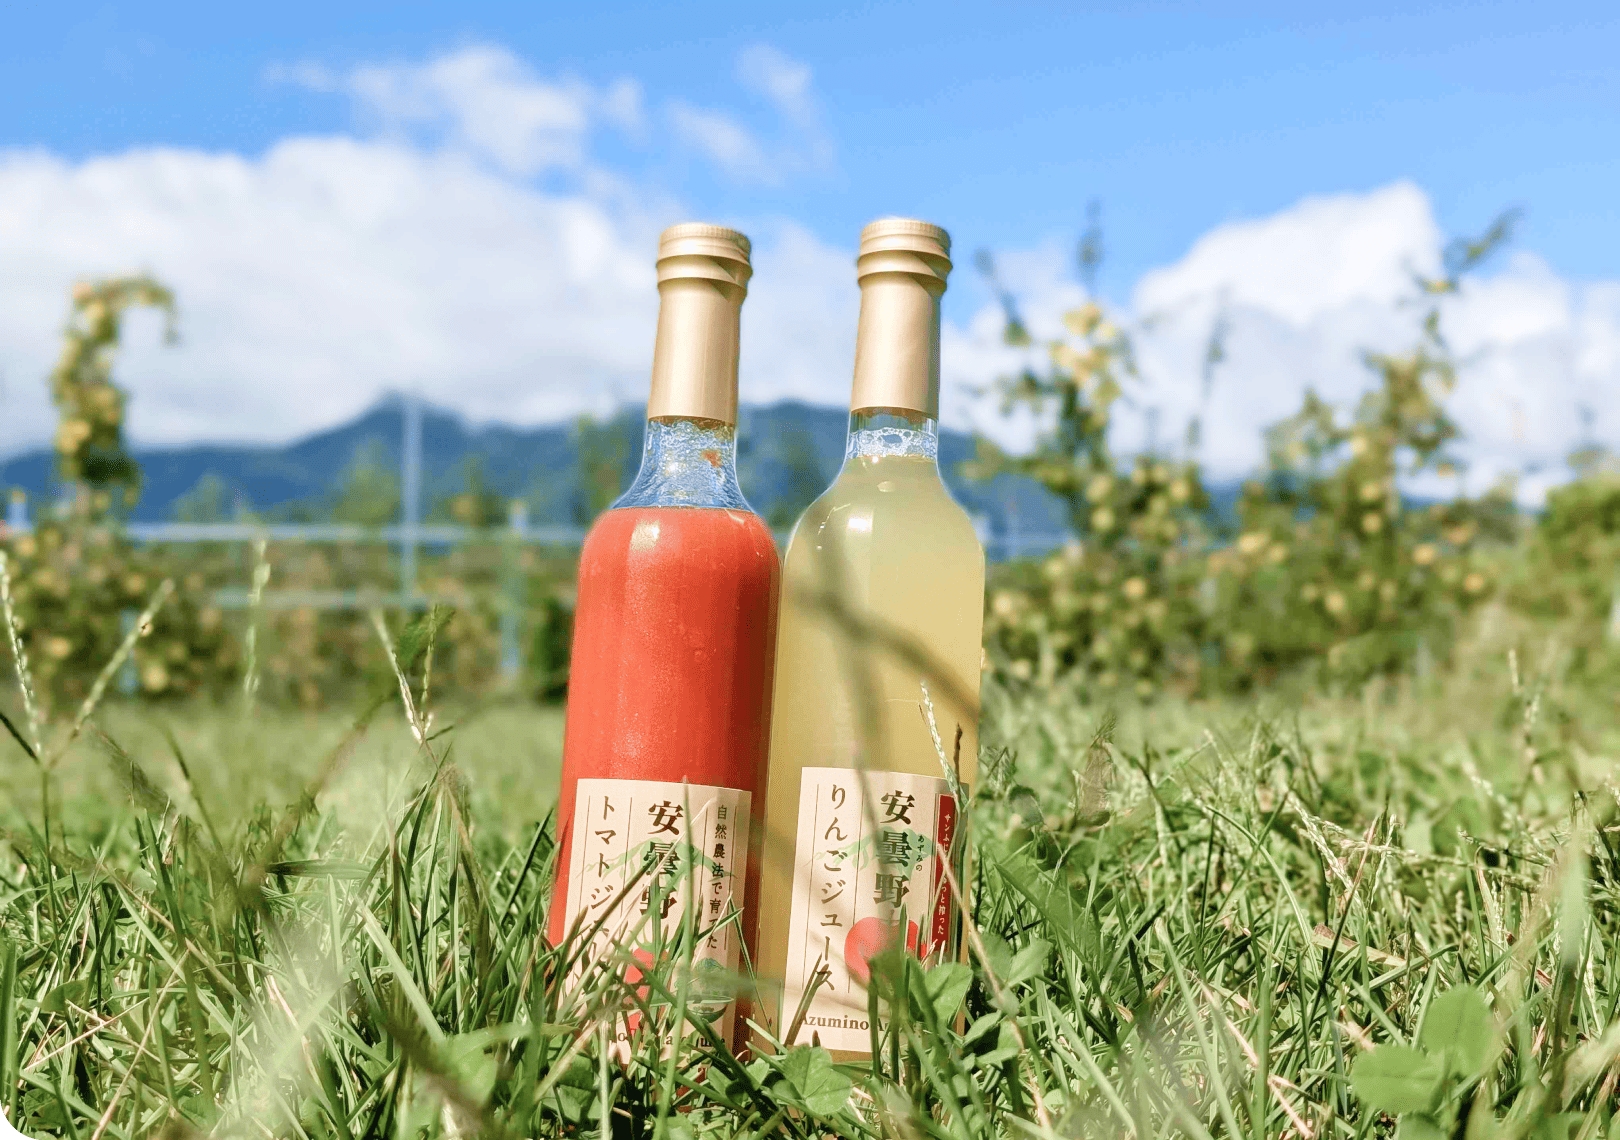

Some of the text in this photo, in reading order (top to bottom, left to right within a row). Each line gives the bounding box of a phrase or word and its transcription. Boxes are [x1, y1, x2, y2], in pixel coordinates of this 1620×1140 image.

[817, 784, 848, 991] りんごジュース
[873, 790, 915, 908] 安曇野
